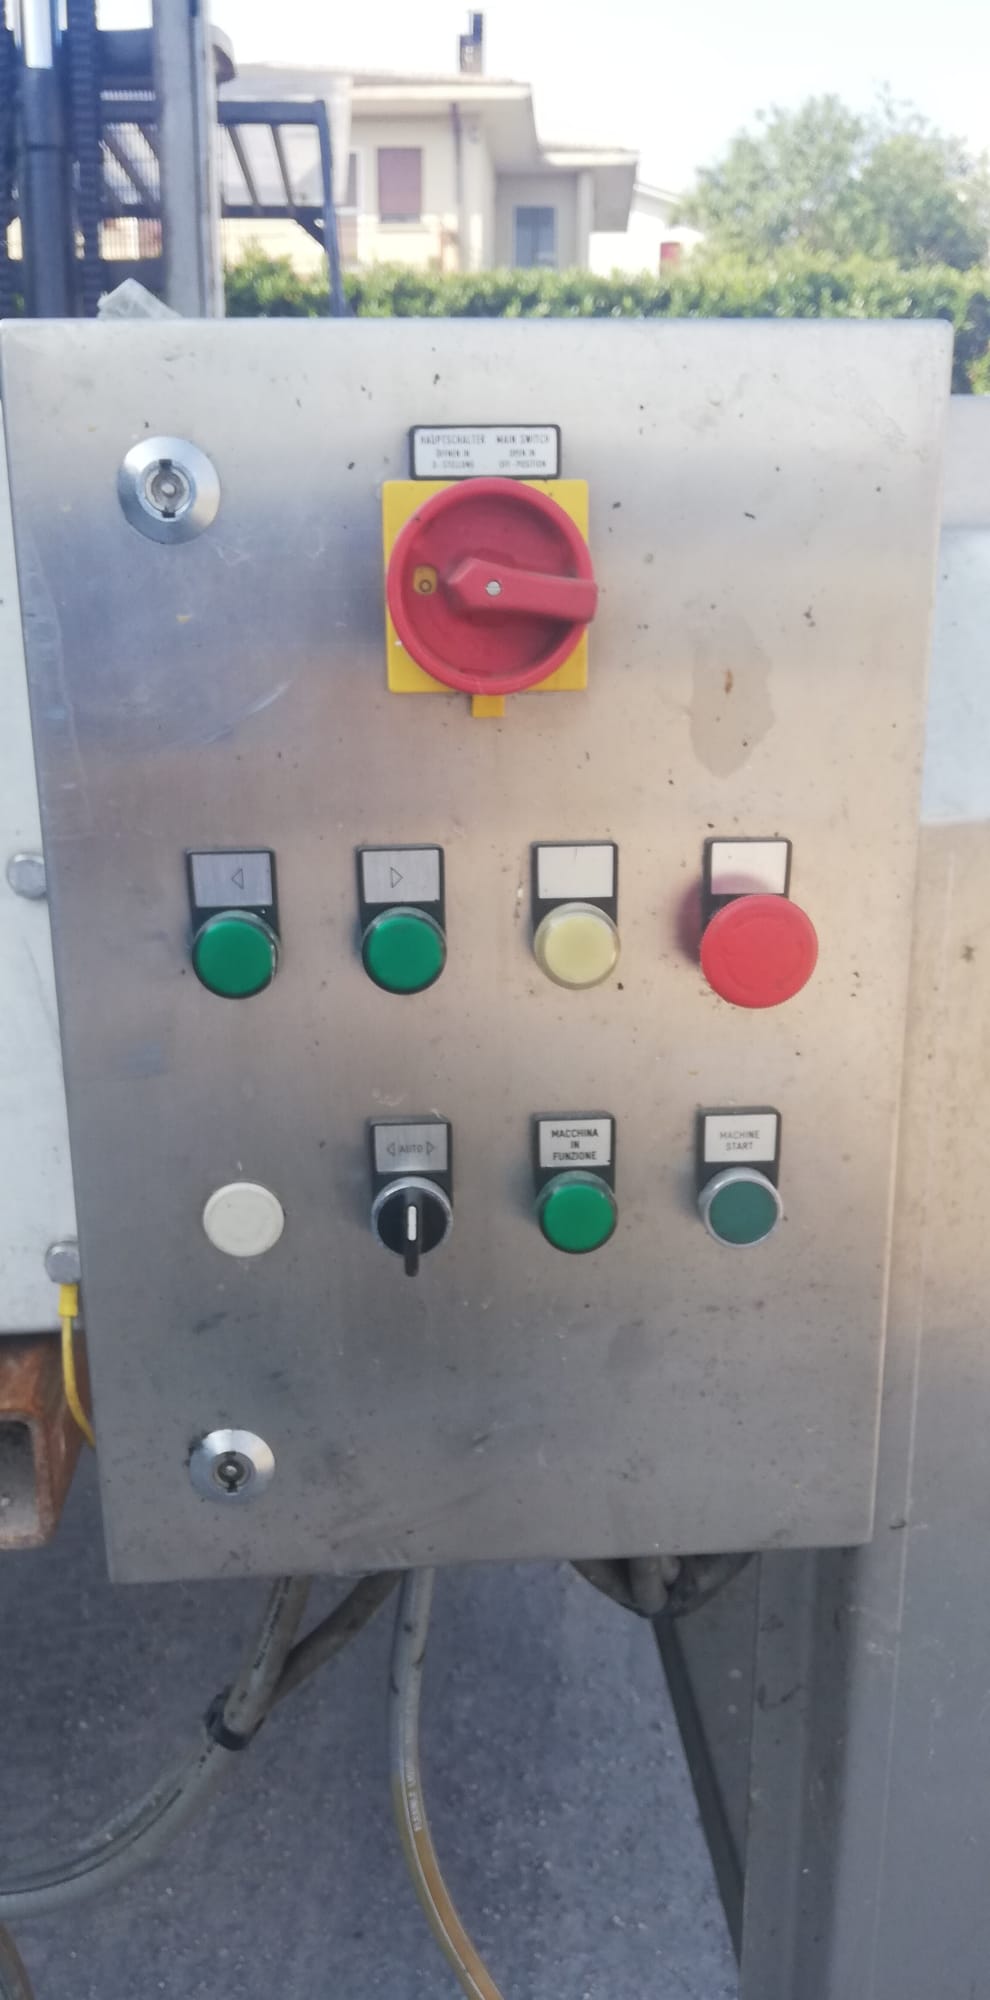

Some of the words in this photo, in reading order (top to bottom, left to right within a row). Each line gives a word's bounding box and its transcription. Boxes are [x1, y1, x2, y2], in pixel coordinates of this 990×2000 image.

[496, 434, 516, 444] MAIN
[520, 434, 550, 444] SWITCH
[551, 1128, 599, 1138] MACCHINA
[719, 1130, 760, 1141] MACHINE
[400, 1144, 424, 1153] AUTO
[570, 1140, 580, 1149] IN
[726, 1142, 753, 1151] START
[553, 1150, 597, 1161] FUNZIONE
